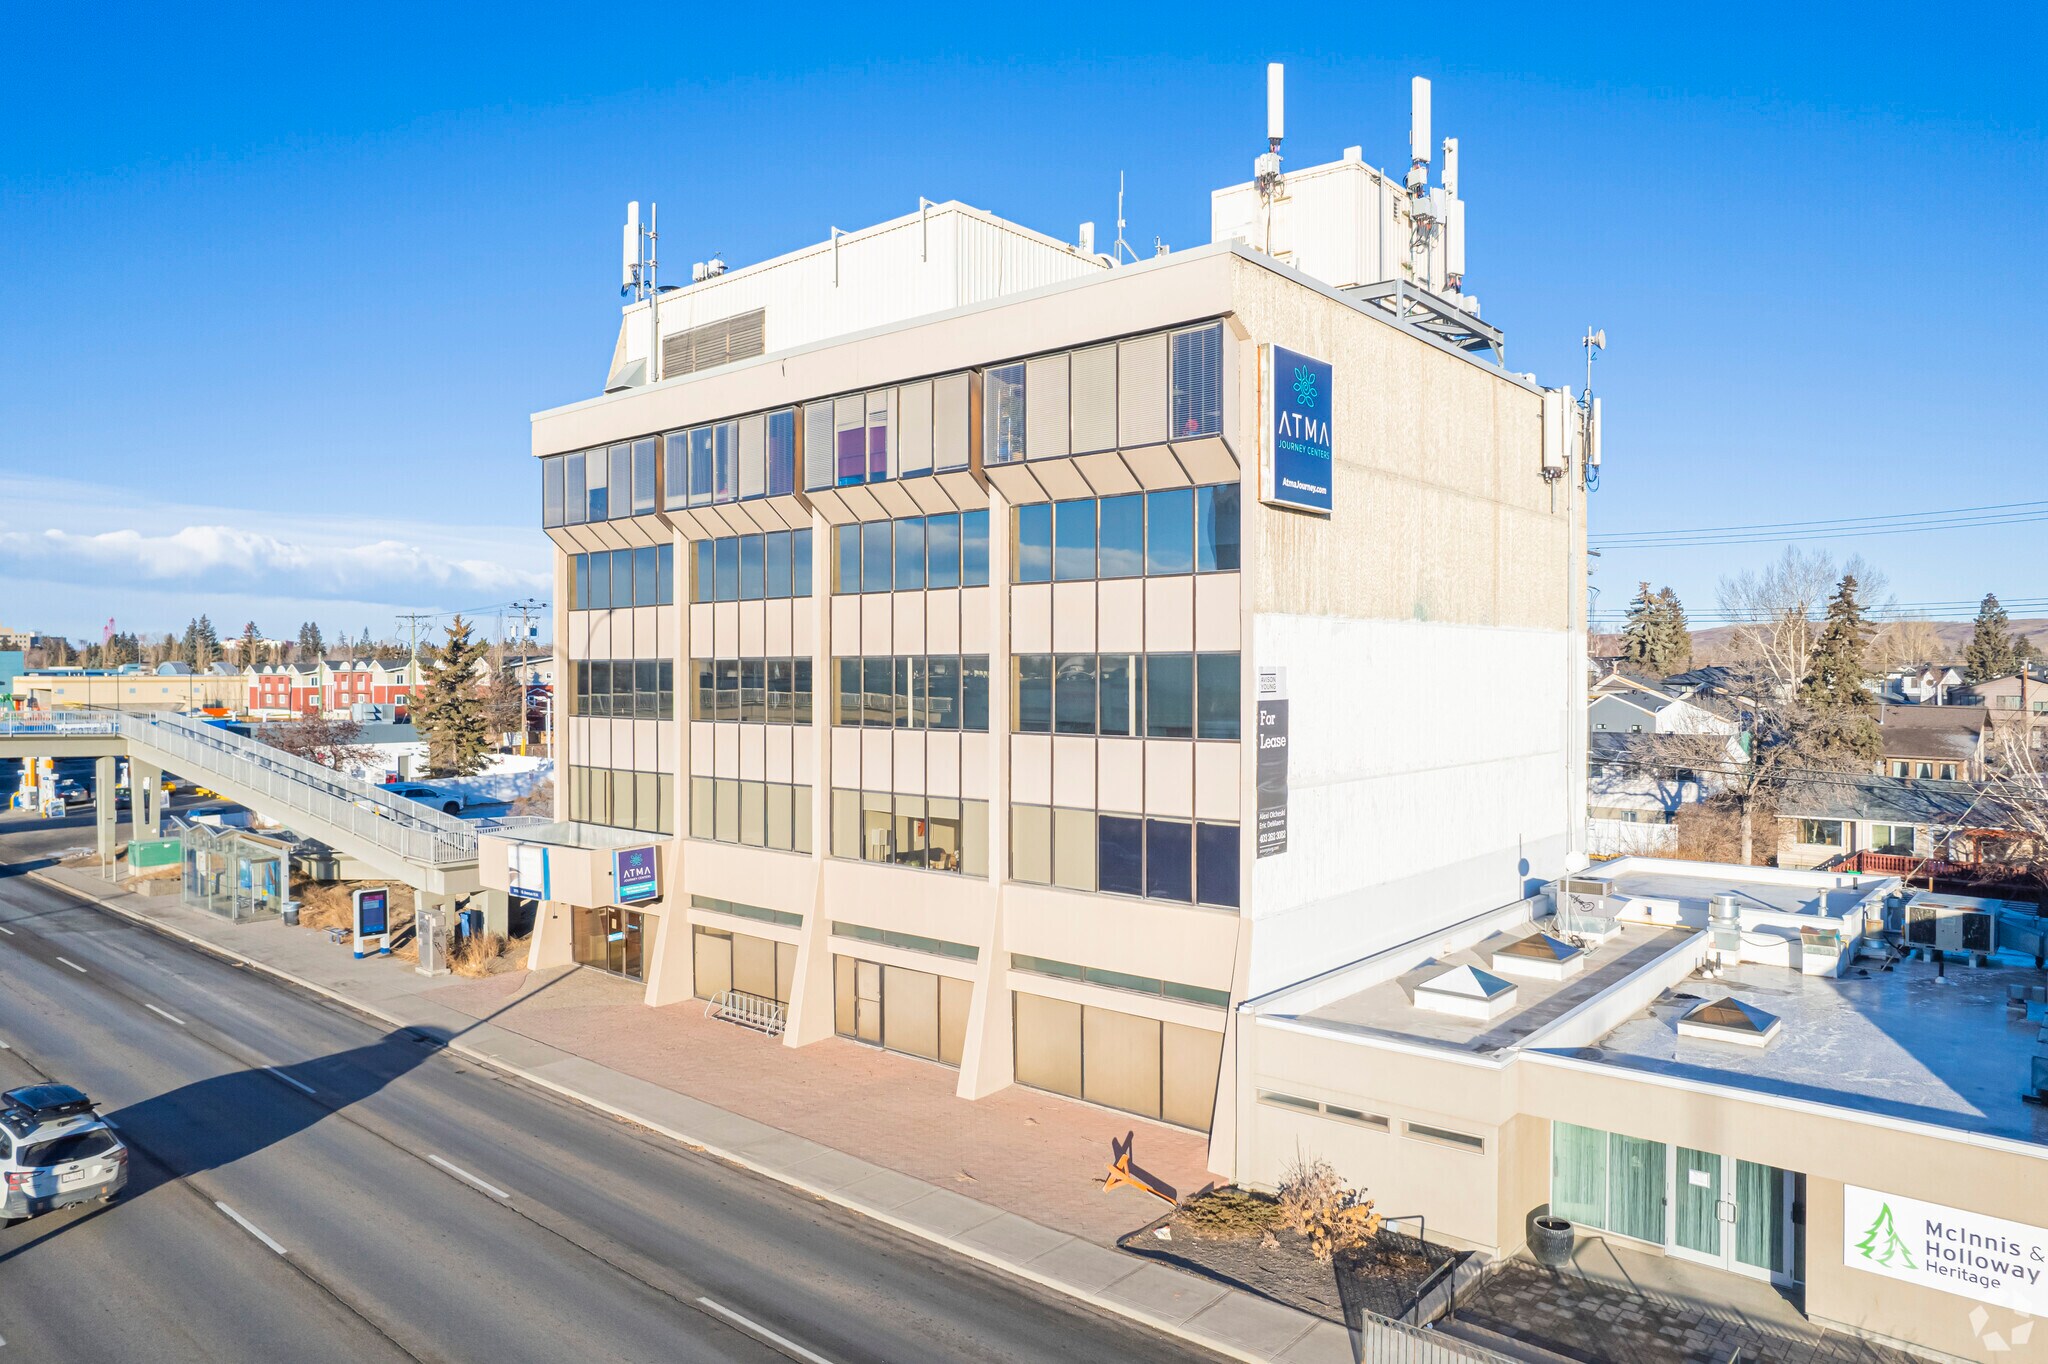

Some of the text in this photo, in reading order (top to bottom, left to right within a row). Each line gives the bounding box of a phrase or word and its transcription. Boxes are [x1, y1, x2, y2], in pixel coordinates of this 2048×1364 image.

[1278, 410, 1330, 447] ATMA
[1278, 439, 1330, 460] JOURNEY CENTERS
[1282, 477, 1327, 495] AtmaJourney.com
[1259, 710, 1276, 726] For
[1259, 733, 1287, 750] Lease
[623, 866, 651, 878] ATMA
[1926, 1219, 2046, 1263] McInnis &
[1926, 1240, 2041, 1285] Holloway
[1926, 1259, 2001, 1289] Heritage
